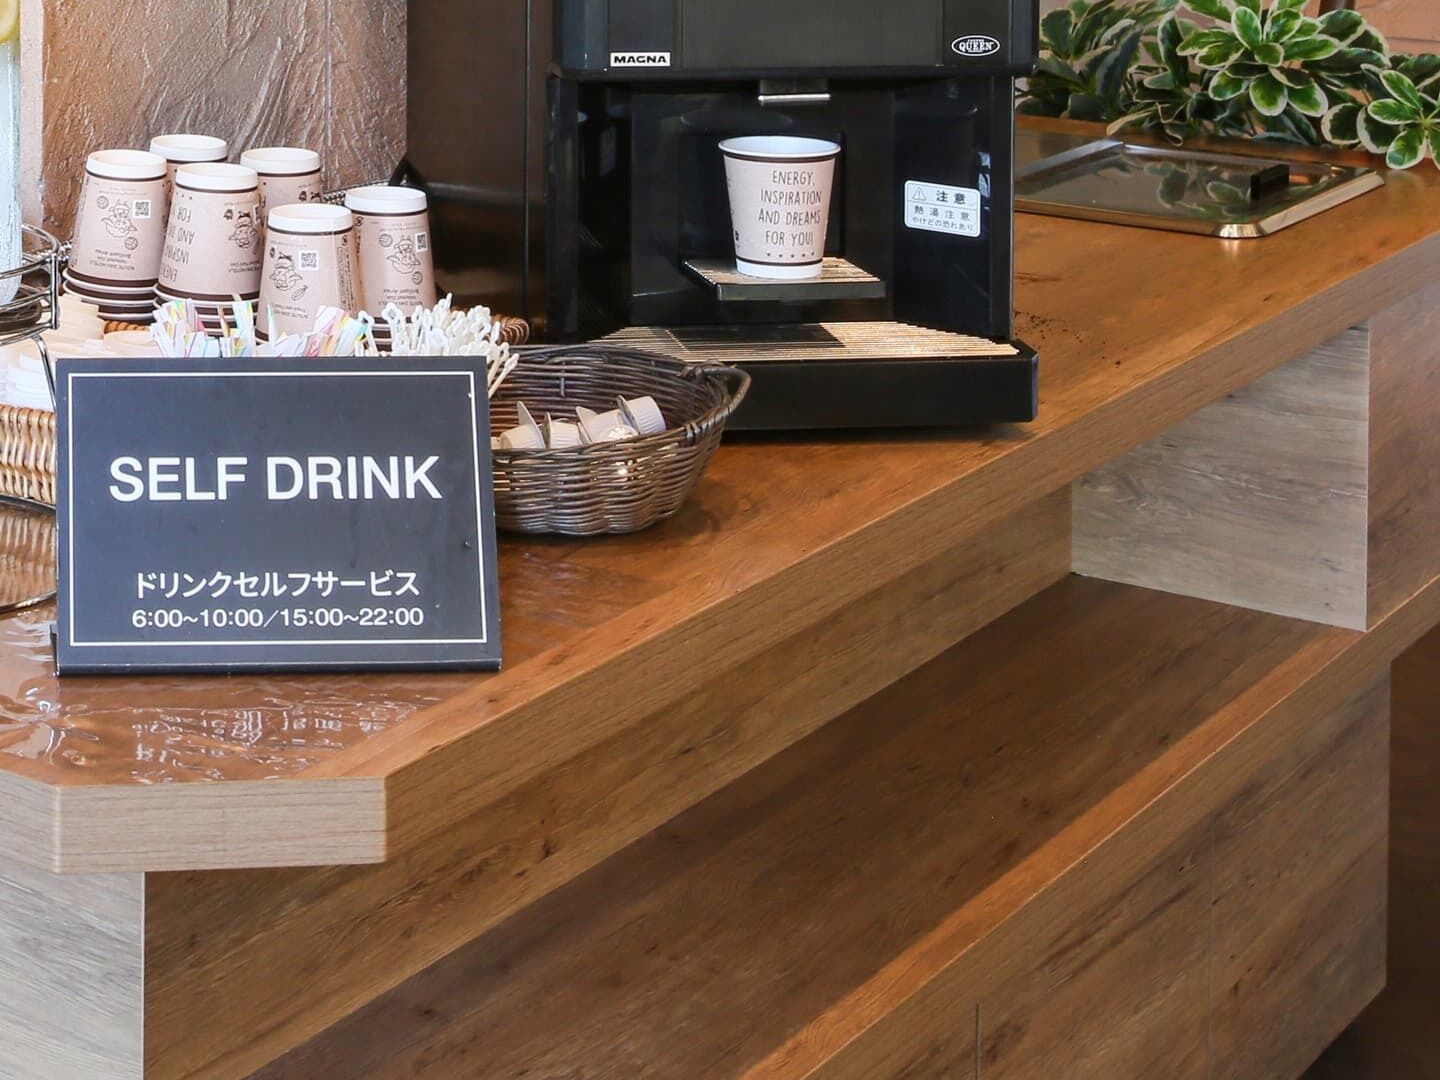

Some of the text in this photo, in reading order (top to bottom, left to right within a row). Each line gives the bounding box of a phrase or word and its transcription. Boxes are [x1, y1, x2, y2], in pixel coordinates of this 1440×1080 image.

[959, 39, 995, 52] QUEEN
[614, 55, 667, 64] MAGNA
[760, 189, 822, 206] INSPIRATION
[936, 190, 966, 205] 注意
[759, 208, 821, 226] AND DREAMS
[765, 230, 814, 247] FOR YOU!
[109, 455, 442, 502] SELF DRINK
[136, 570, 420, 599] ドリンクセルフサービス
